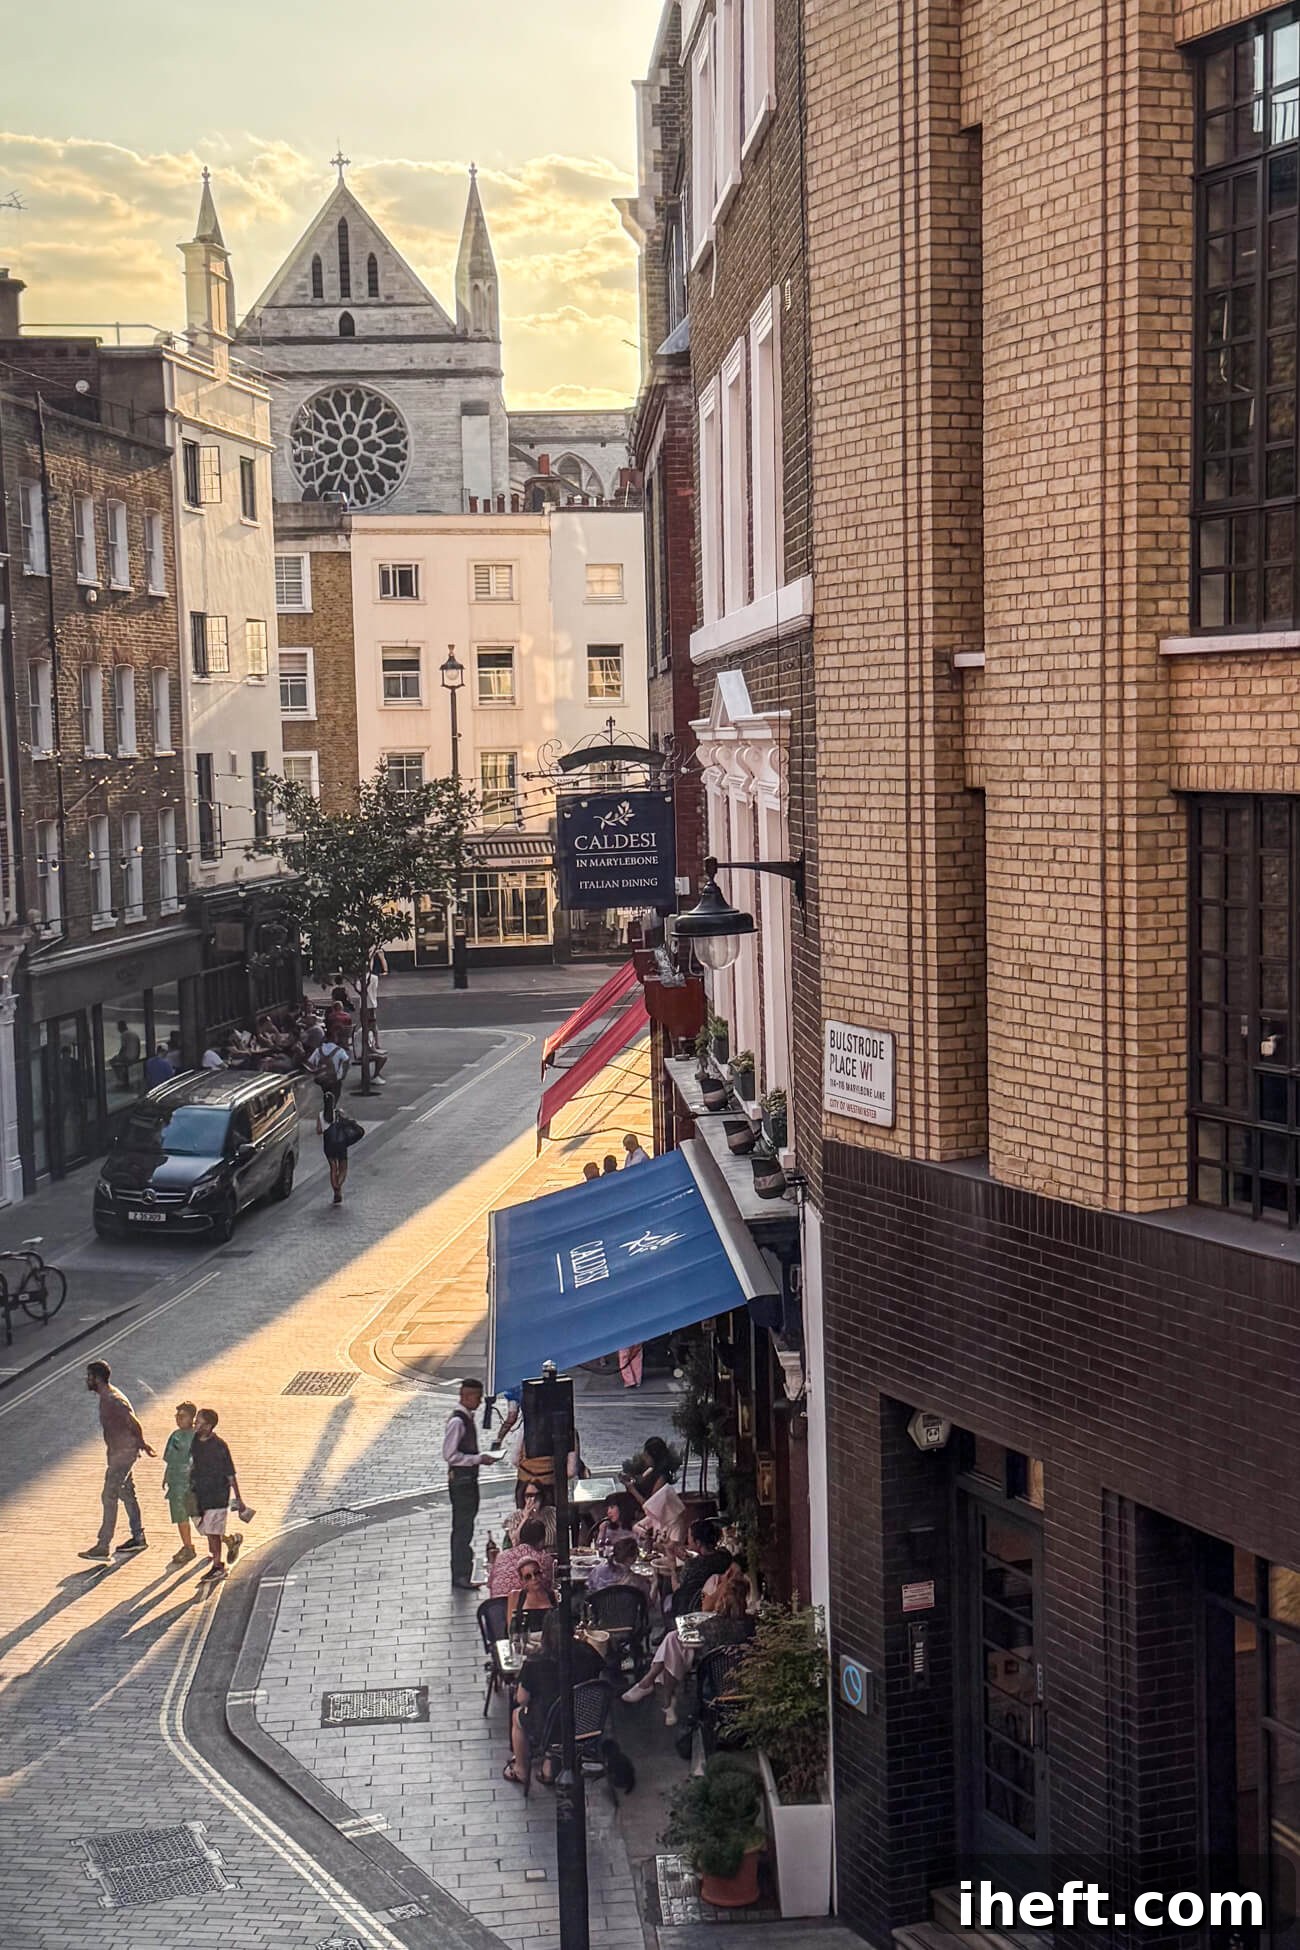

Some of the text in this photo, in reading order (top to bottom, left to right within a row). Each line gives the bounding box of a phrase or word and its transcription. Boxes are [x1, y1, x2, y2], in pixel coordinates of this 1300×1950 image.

[574, 832, 657, 850] CALDESI
[576, 856, 659, 868] IN MARYLEBONE
[579, 877, 658, 889] ITALIAN DINING
[830, 1030, 884, 1060] BULSTRODE
[829, 1053, 873, 1082] PLACE W1
[873, 1089, 886, 1102] LANE
[829, 1098, 839, 1108] CITY
[846, 1103, 877, 1118] WESTMINSTER
[569, 1240, 610, 1289] CALDESI
